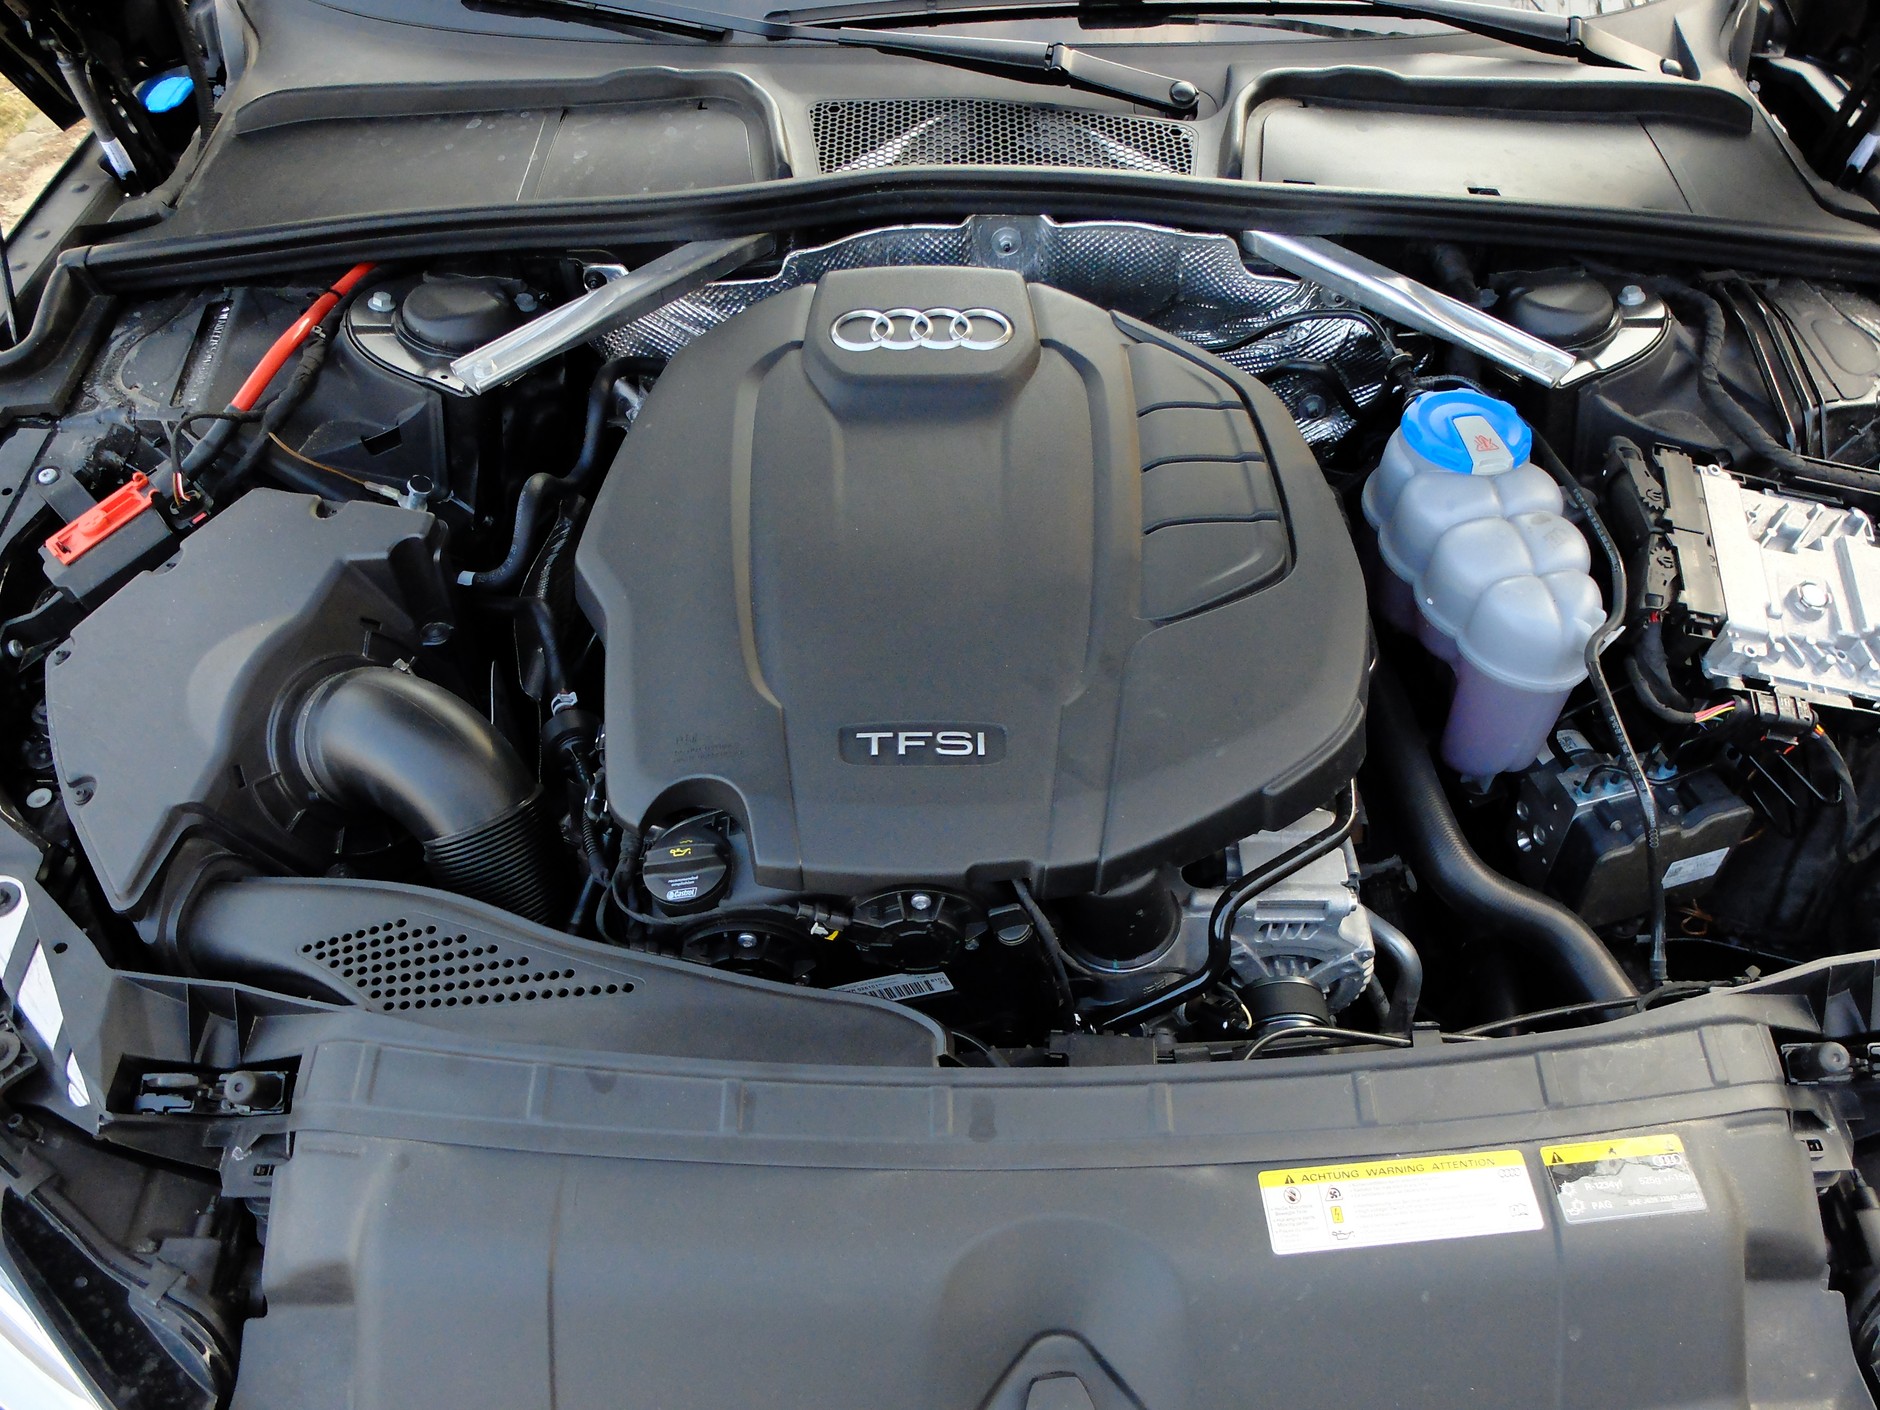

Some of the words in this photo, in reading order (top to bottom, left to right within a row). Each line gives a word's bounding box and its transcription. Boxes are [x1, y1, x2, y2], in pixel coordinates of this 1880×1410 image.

[856, 731, 986, 756] TFSI
[1301, 1169, 1360, 1183] ACHTUNG
[1366, 1163, 1425, 1177] WARNING
[1432, 1158, 1496, 1171] ATTENTION
[1592, 1199, 1613, 1210] PAG
